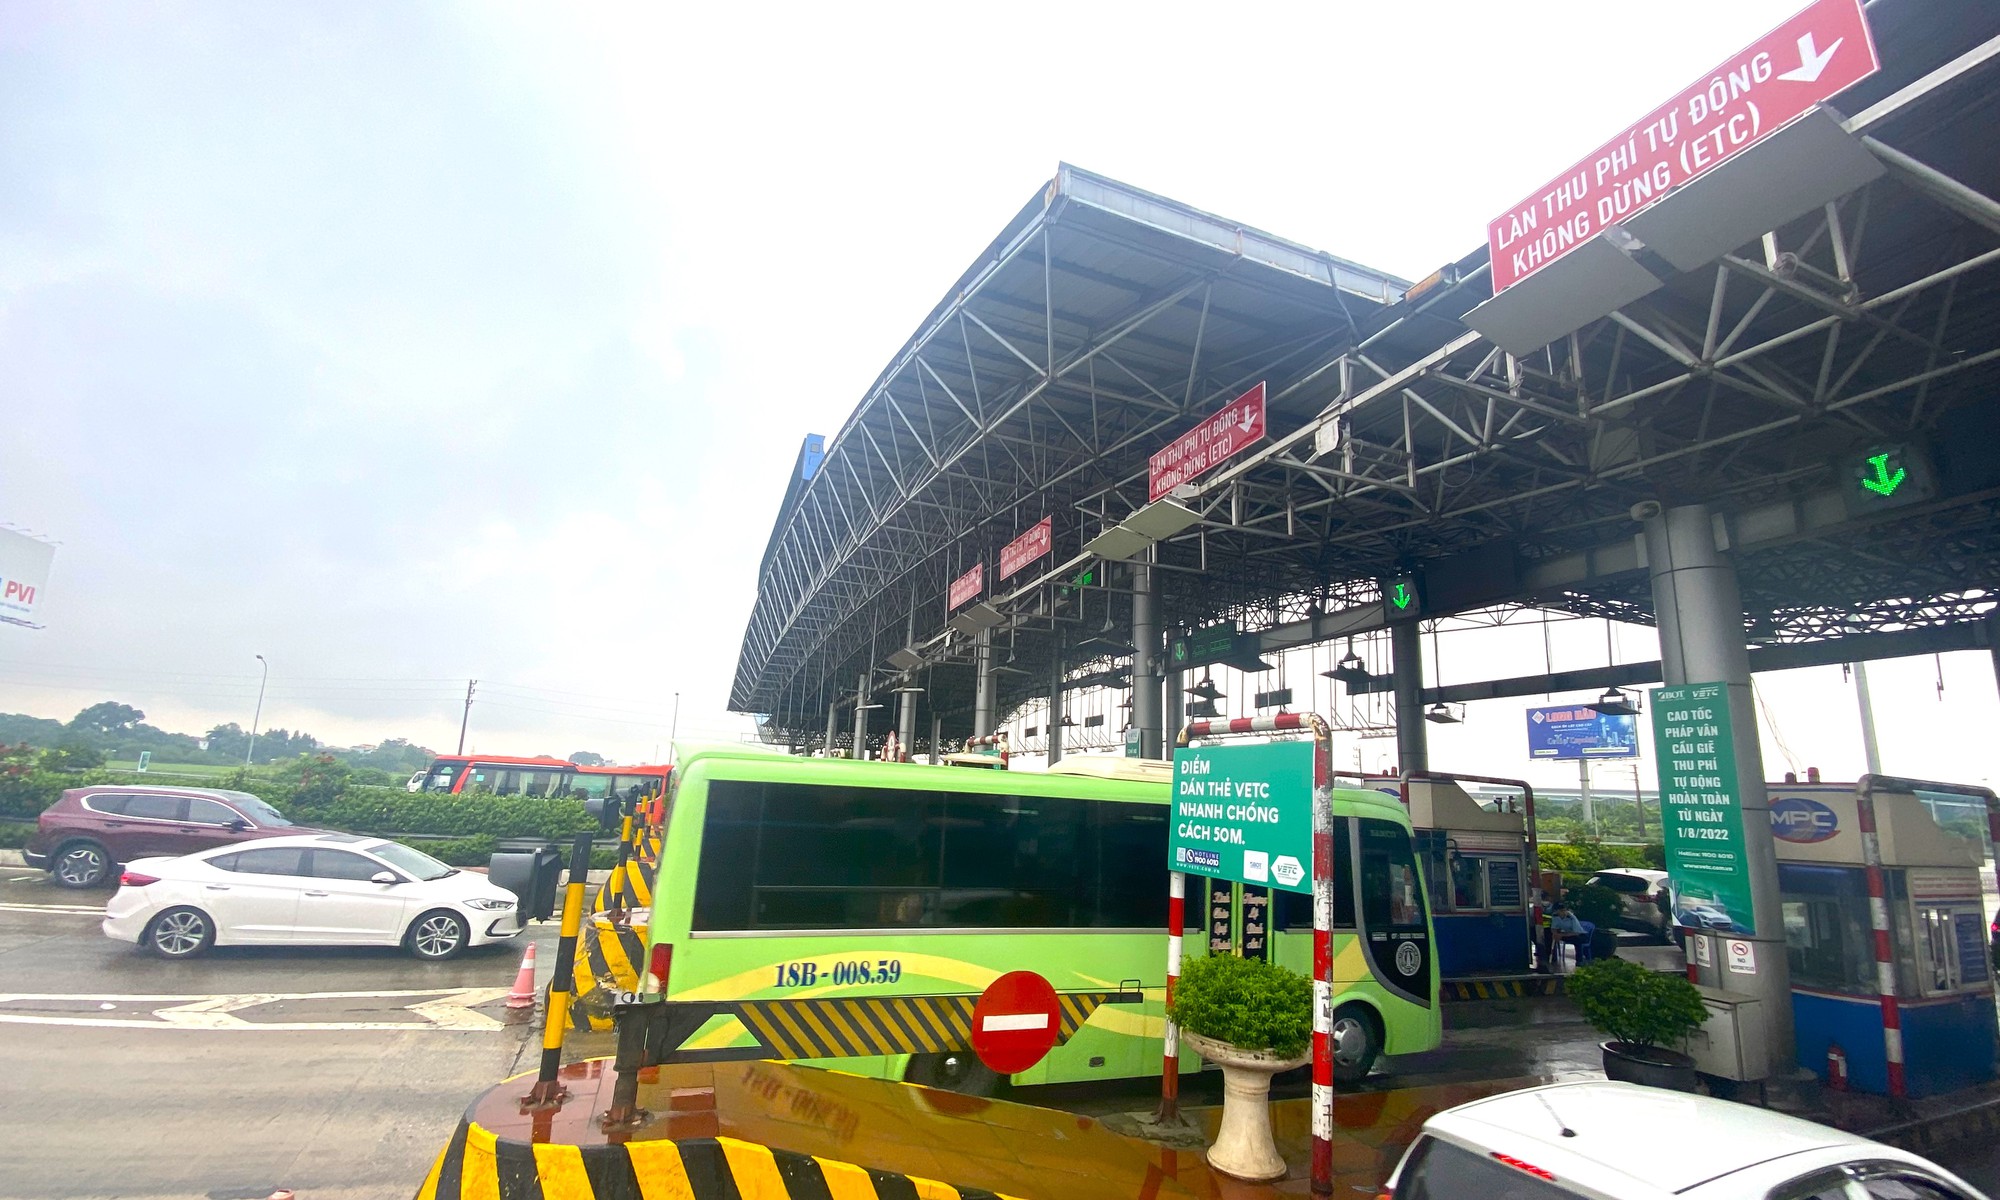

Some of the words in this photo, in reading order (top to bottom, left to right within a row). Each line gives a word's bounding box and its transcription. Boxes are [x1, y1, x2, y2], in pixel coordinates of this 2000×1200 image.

[1497, 205, 1537, 251] LÀN
[1542, 171, 1588, 219] THU
[1595, 129, 1637, 187] PHÍ
[1643, 107, 1679, 153] TỰ
[1688, 51, 1772, 126] ĐỘNG
[1512, 210, 1590, 277] KHÔNG
[1598, 161, 1671, 226] DỪNG
[1680, 101, 1760, 175] (ETC)
[1167, 446, 1182, 466] THU
[1184, 436, 1198, 456] PHÍ
[1156, 467, 1182, 495] KHÔNG
[1209, 434, 1233, 464] (ETC)
[5, 580, 36, 604] PVI
[1692, 687, 1719, 698] VETC
[1667, 710, 1688, 721] CAO
[1690, 706, 1712, 720] TỐC
[1665, 724, 1694, 738] PHÁP
[1696, 723, 1719, 737] VÂN
[1181, 754, 1210, 774] ĐIỂM
[1672, 760, 1694, 771] THU
[1697, 757, 1717, 771] PHÍ
[1180, 777, 1205, 796] DÁN
[1207, 777, 1231, 797] THẺ
[1234, 782, 1270, 798] VETC
[1673, 776, 1687, 789] TỰ
[1690, 774, 1721, 790] ĐỘNG
[1668, 791, 1698, 805] HOÀN
[1701, 791, 1730, 805] TOÀN
[1179, 802, 1223, 819] NHANH
[1226, 801, 1279, 823] CHÓNG
[1677, 807, 1692, 821] TỪ
[1695, 808, 1724, 822] NGÀY
[1770, 810, 1832, 827] MPC
[1178, 820, 1211, 840] CÁCH
[1213, 826, 1246, 845] 50M.
[1677, 827, 1729, 840] 1/8/2022
[1194, 851, 1219, 859] HOTLINE
[1194, 856, 1206, 865] 1900
[1277, 865, 1298, 875] VETC
